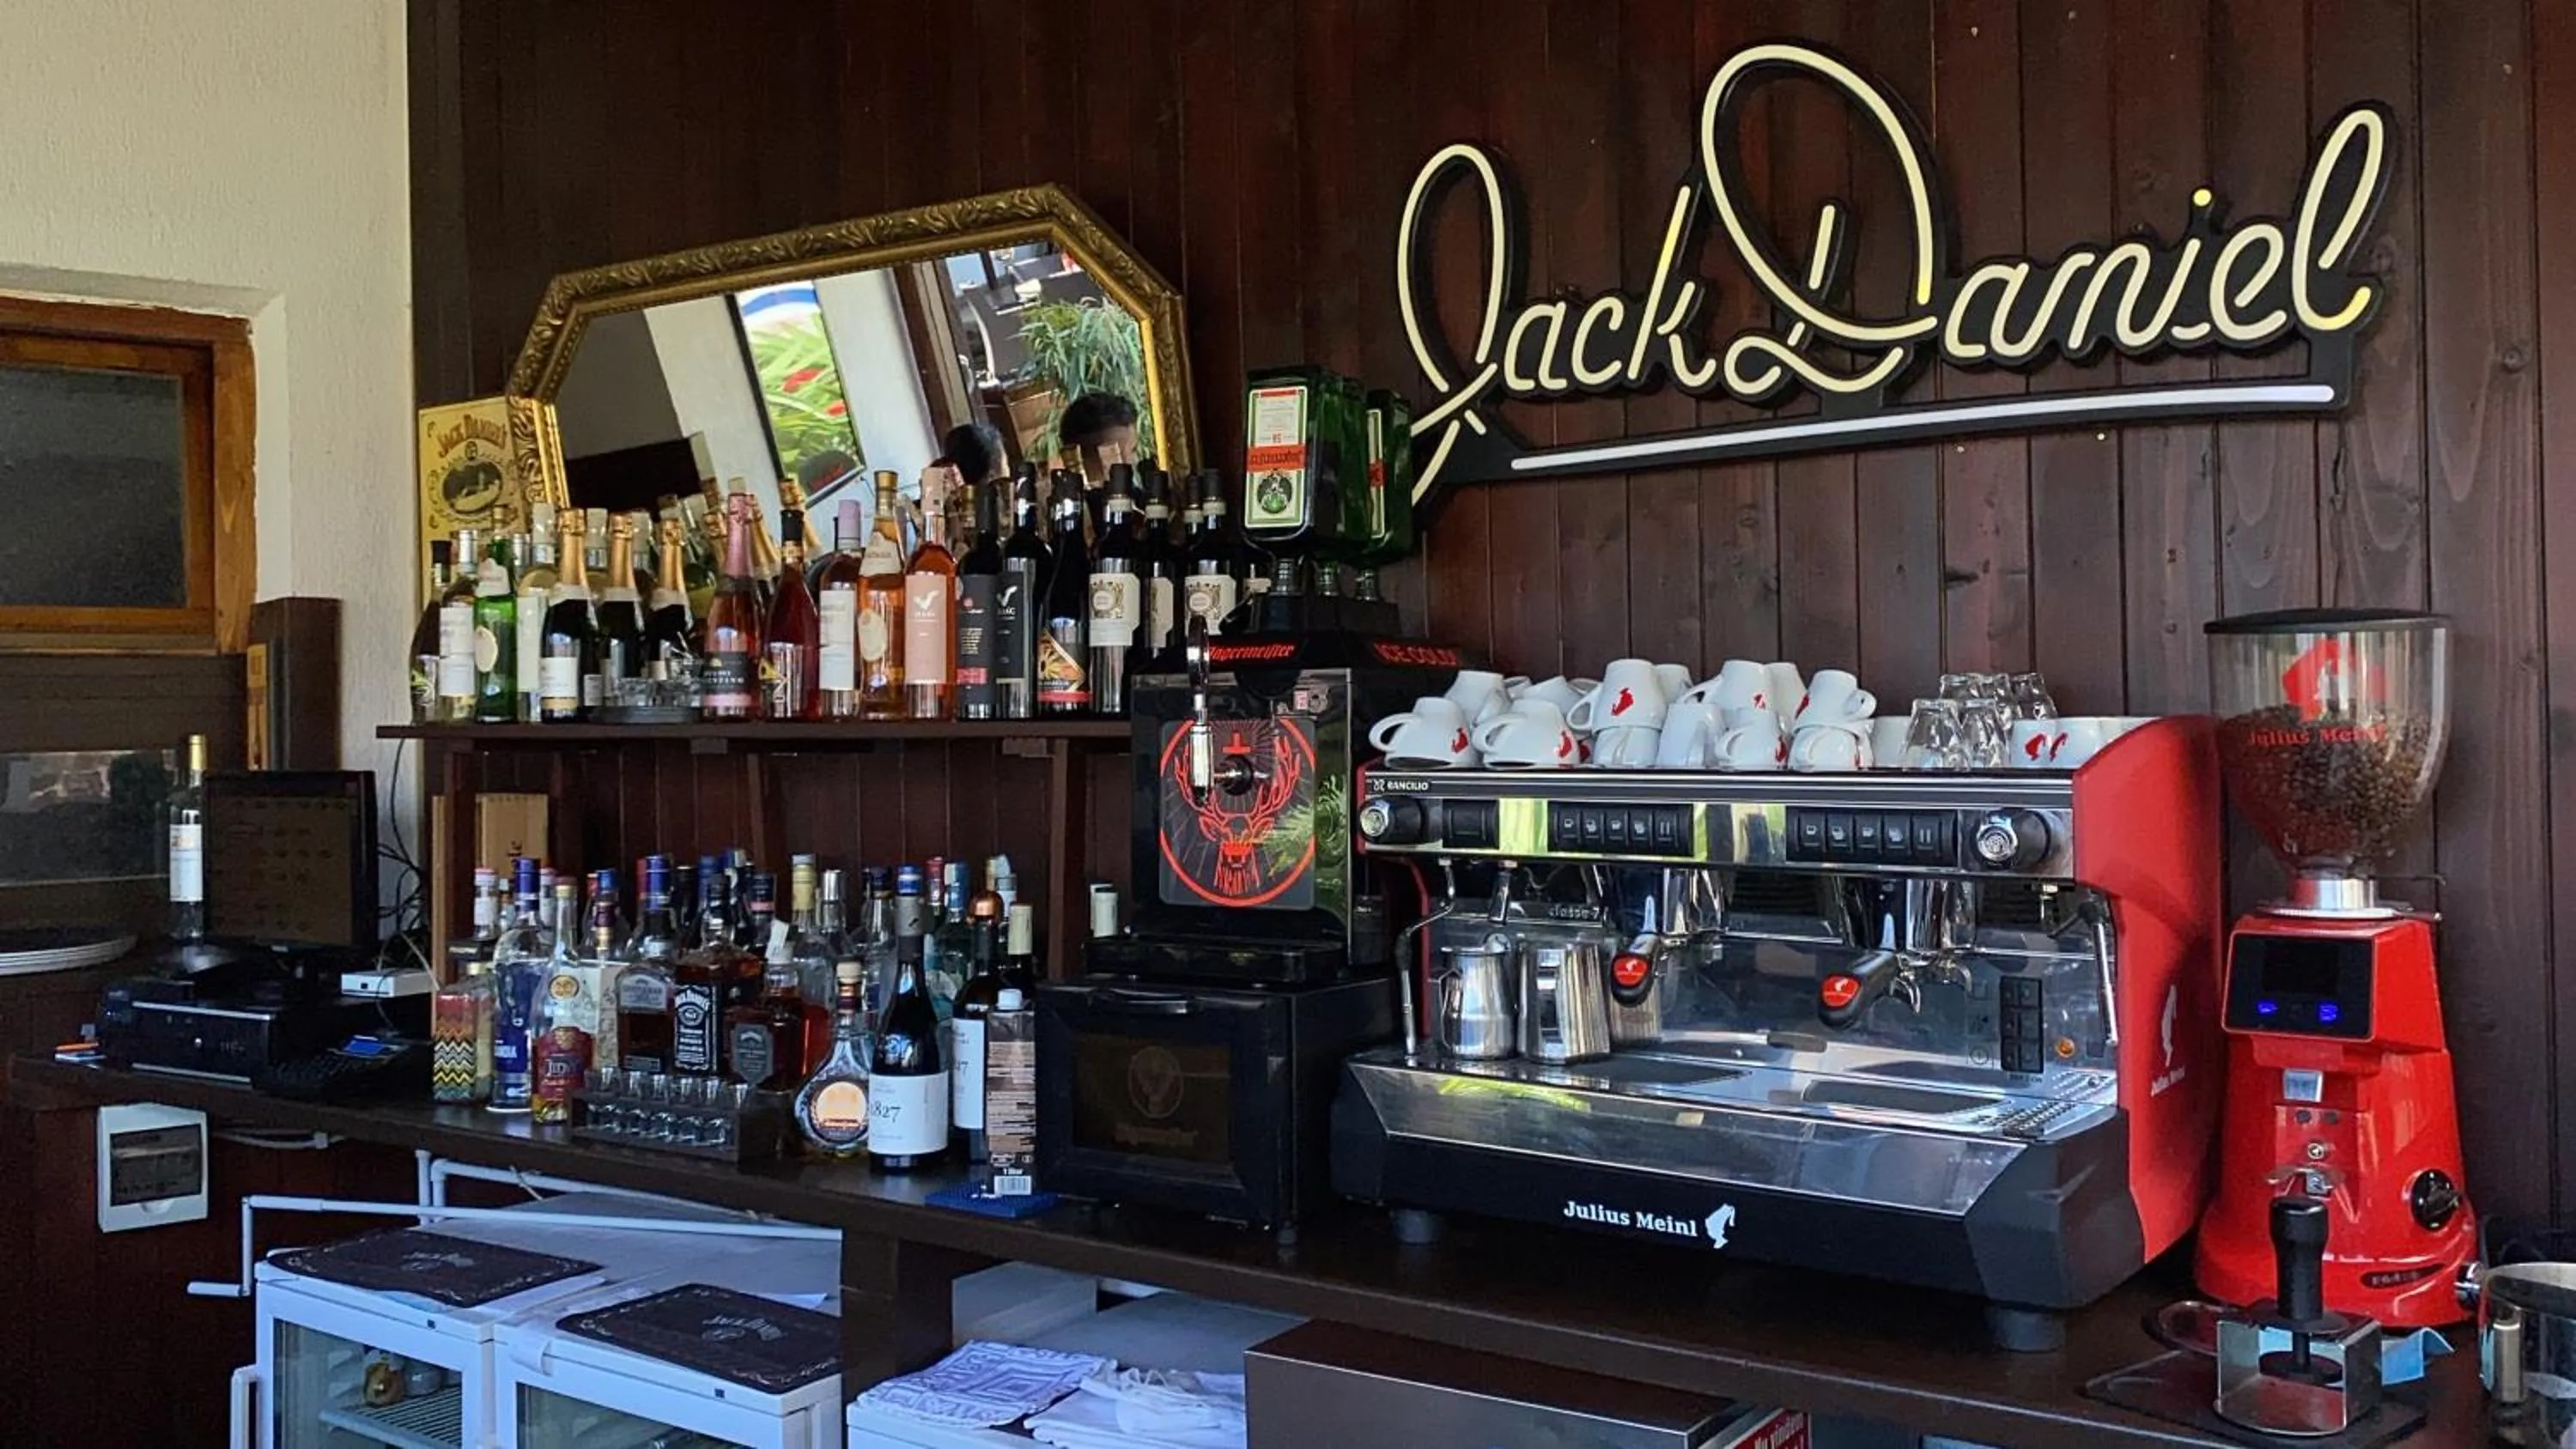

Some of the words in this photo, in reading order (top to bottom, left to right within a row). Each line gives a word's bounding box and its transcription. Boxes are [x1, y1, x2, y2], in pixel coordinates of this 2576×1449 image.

[1396, 142, 1717, 506] Jack
[1700, 43, 2385, 395] Daniel
[1387, 780, 1429, 791] RANCILIO
[1563, 1200, 1631, 1226] Julius
[1635, 1210, 1698, 1238] Meinl
